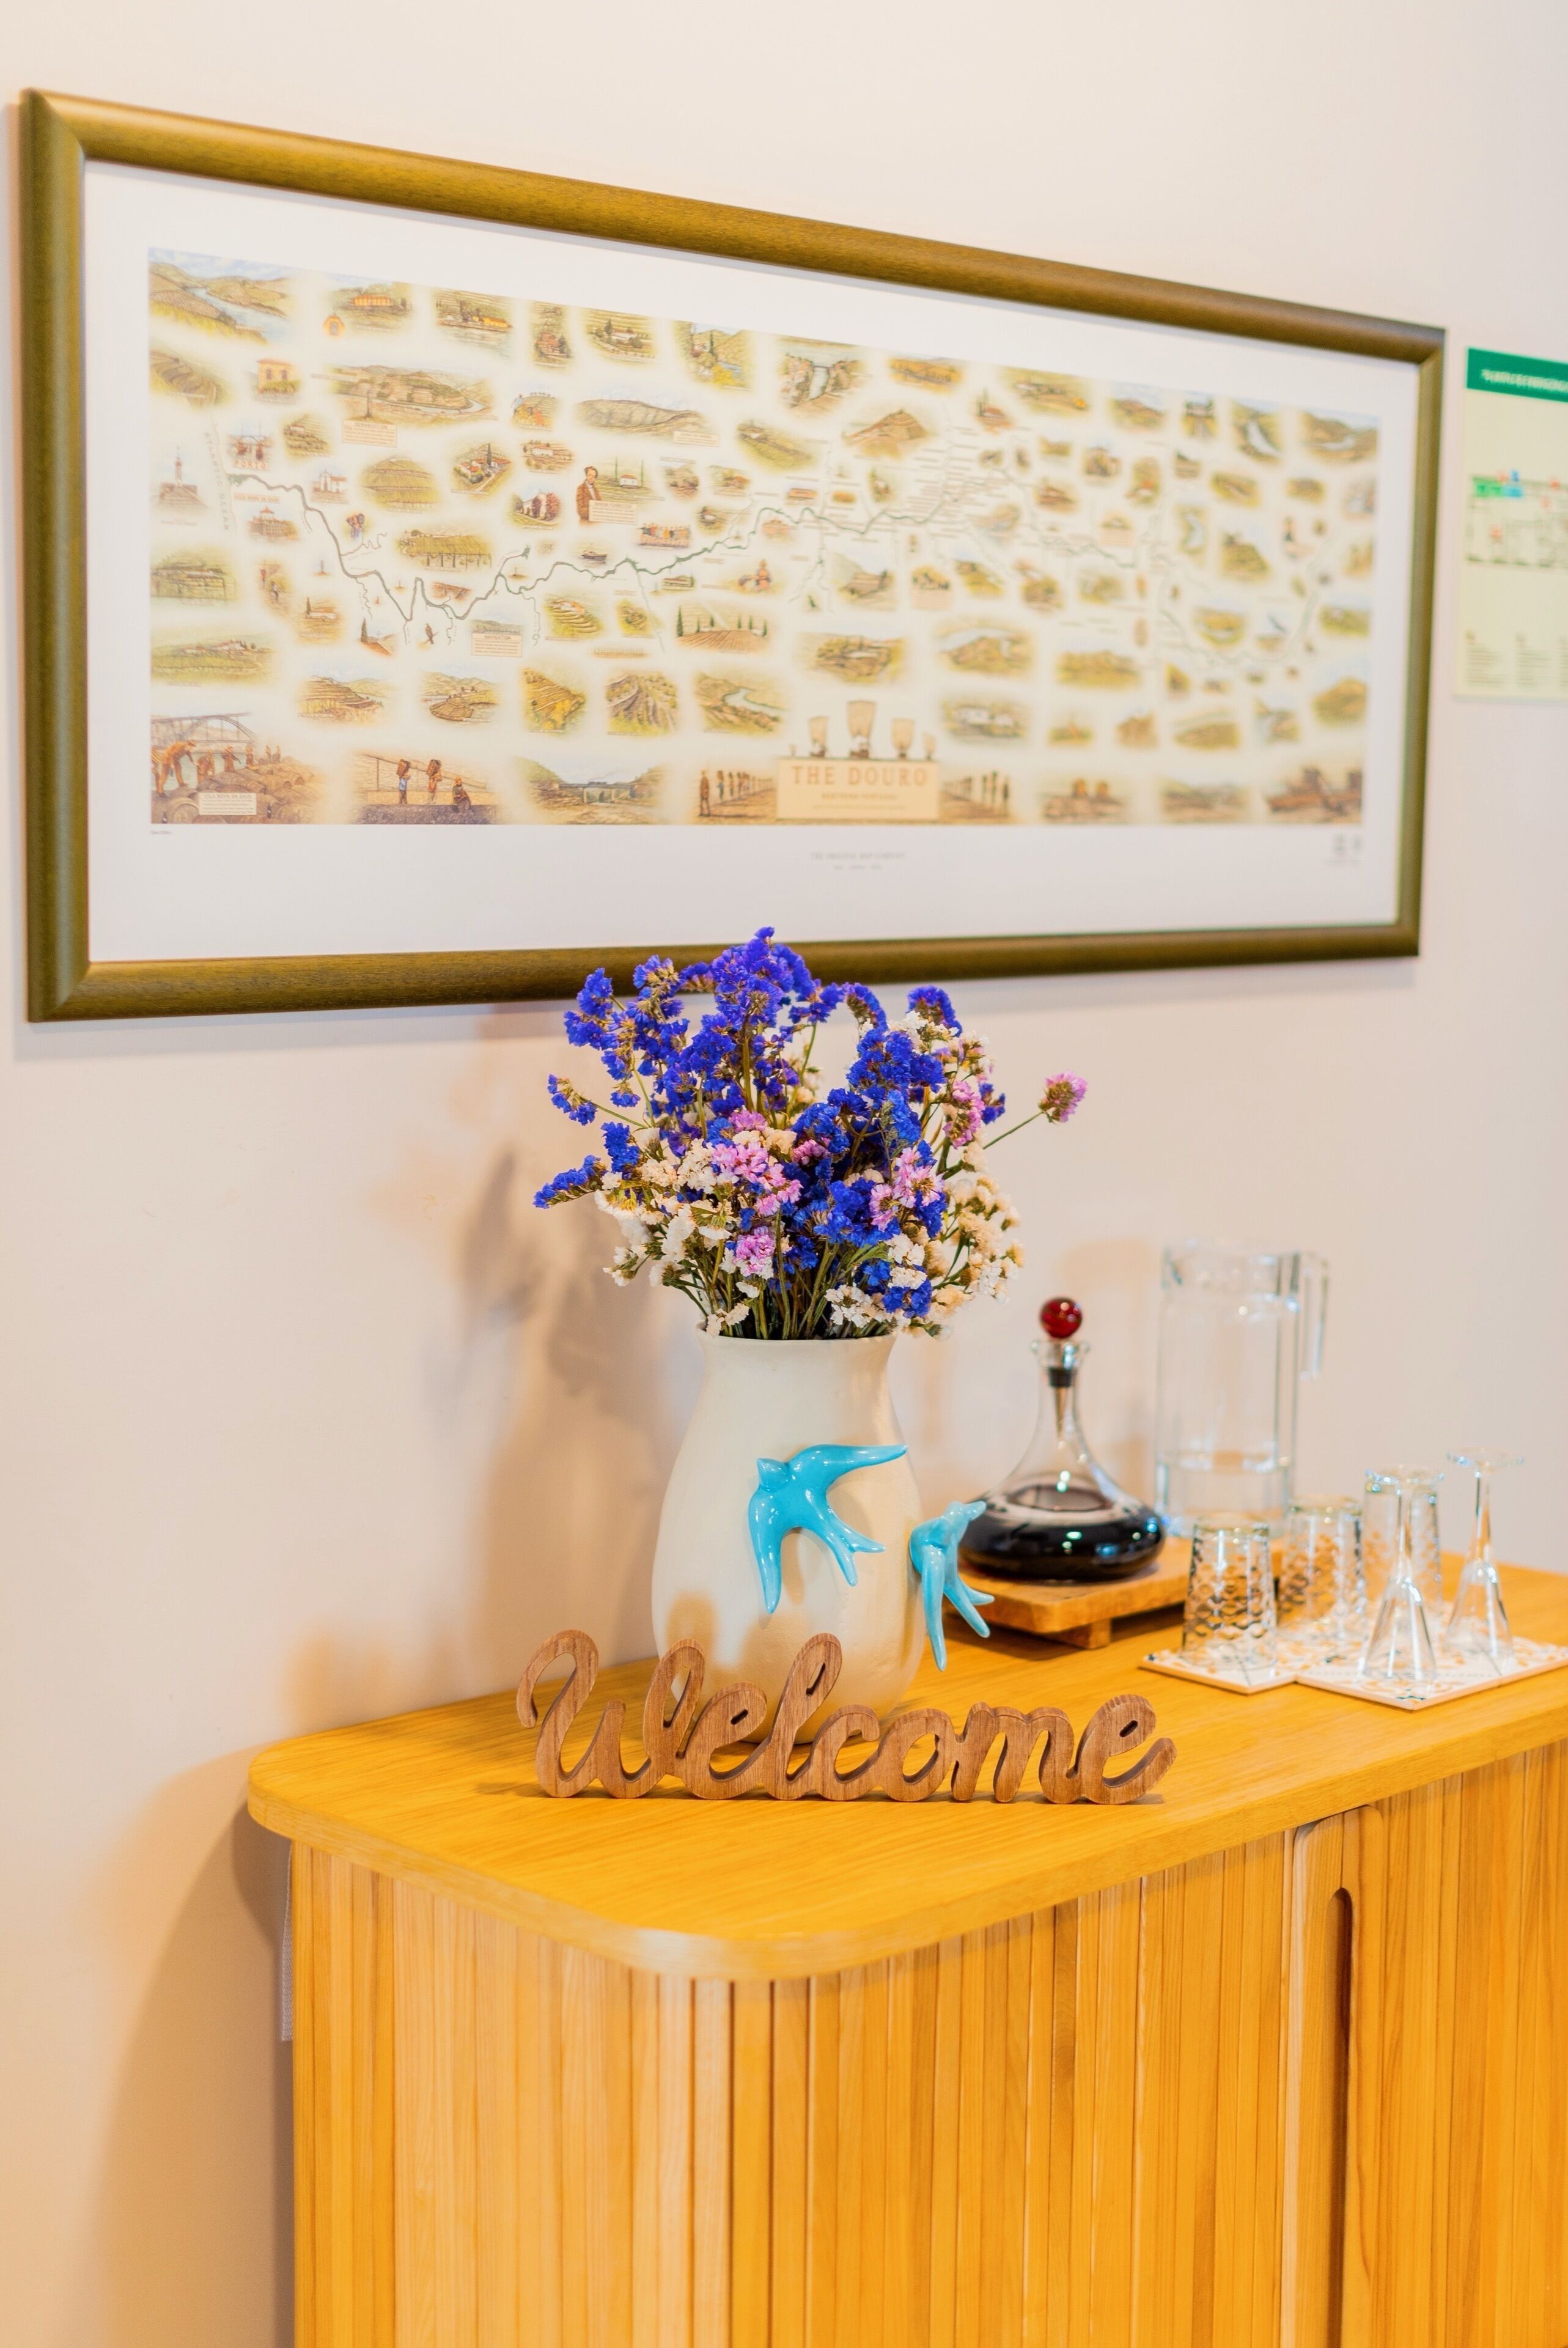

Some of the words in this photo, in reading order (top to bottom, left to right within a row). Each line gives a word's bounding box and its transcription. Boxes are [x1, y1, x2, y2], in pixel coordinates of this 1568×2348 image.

[792, 766, 834, 785] THE
[848, 767, 927, 786] DOURO
[516, 1630, 1177, 1804] Welcome
